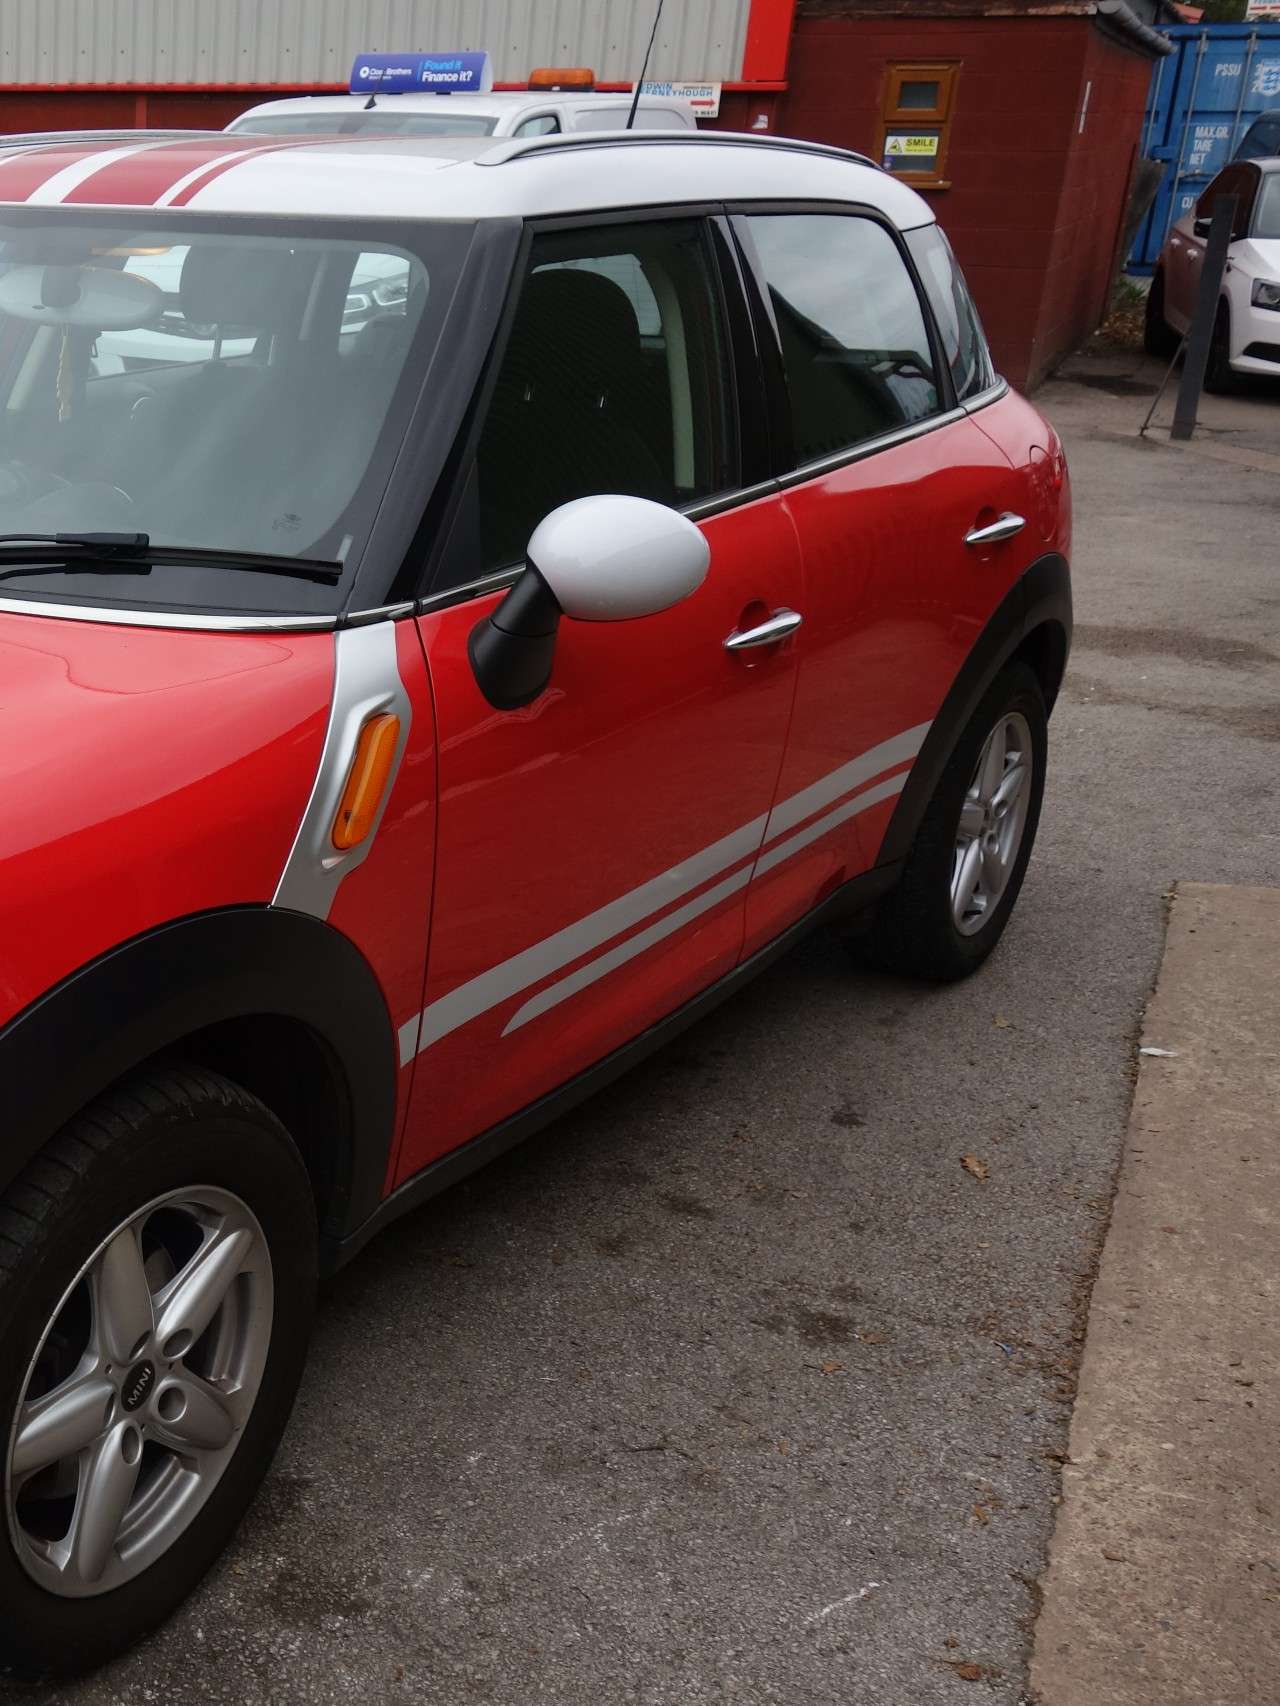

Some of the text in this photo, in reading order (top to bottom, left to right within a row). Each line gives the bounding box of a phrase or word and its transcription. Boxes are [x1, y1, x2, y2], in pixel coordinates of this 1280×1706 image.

[1215, 63, 1241, 76] PSSU
[422, 70, 473, 82] Finance it?
[905, 138, 935, 147] SMILE
[1193, 139, 1213, 152] TARE
[1189, 153, 1206, 165] NET
[127, 1366, 152, 1406] MINI
